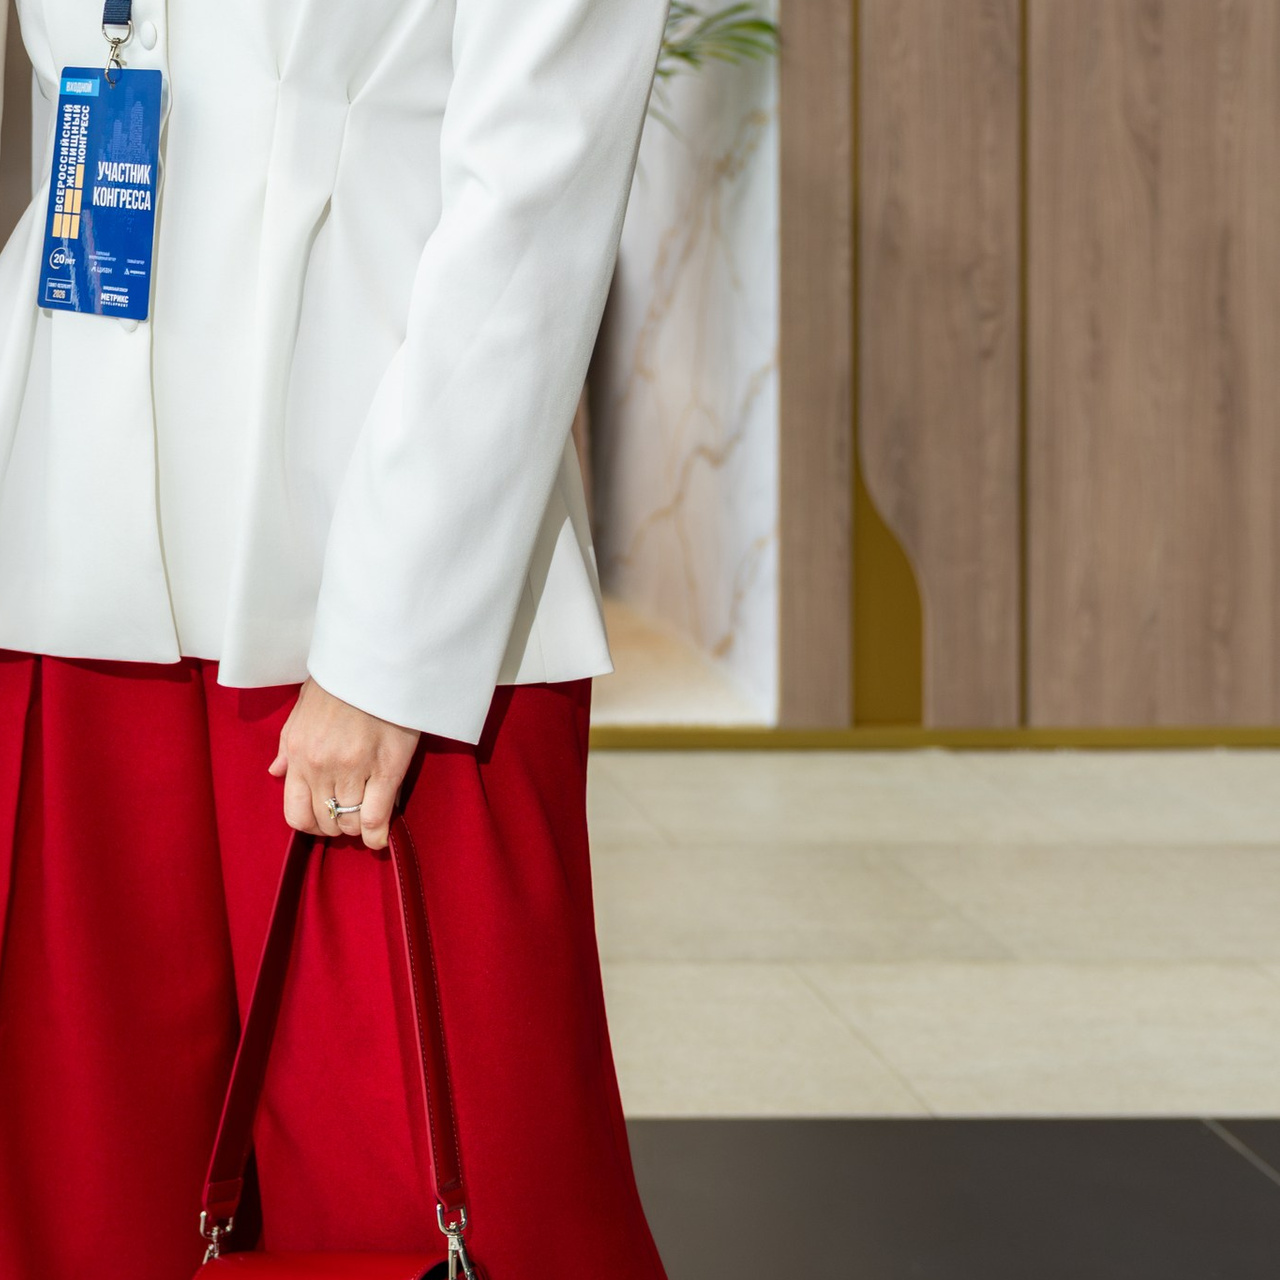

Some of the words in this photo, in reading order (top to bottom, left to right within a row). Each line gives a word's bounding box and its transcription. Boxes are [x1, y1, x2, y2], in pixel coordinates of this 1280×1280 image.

[66, 81, 93, 93] ВХОДНОЙ
[66, 104, 82, 187] ЖИЛИЩНЫЙ
[77, 105, 90, 163] КОНГРЕСС
[54, 104, 74, 212] ВСЕРОССИЙСКИЙ
[97, 161, 151, 185] УЧАСТНИК
[92, 186, 151, 211] КОНГРЕССА
[53, 254, 65, 264] 20
